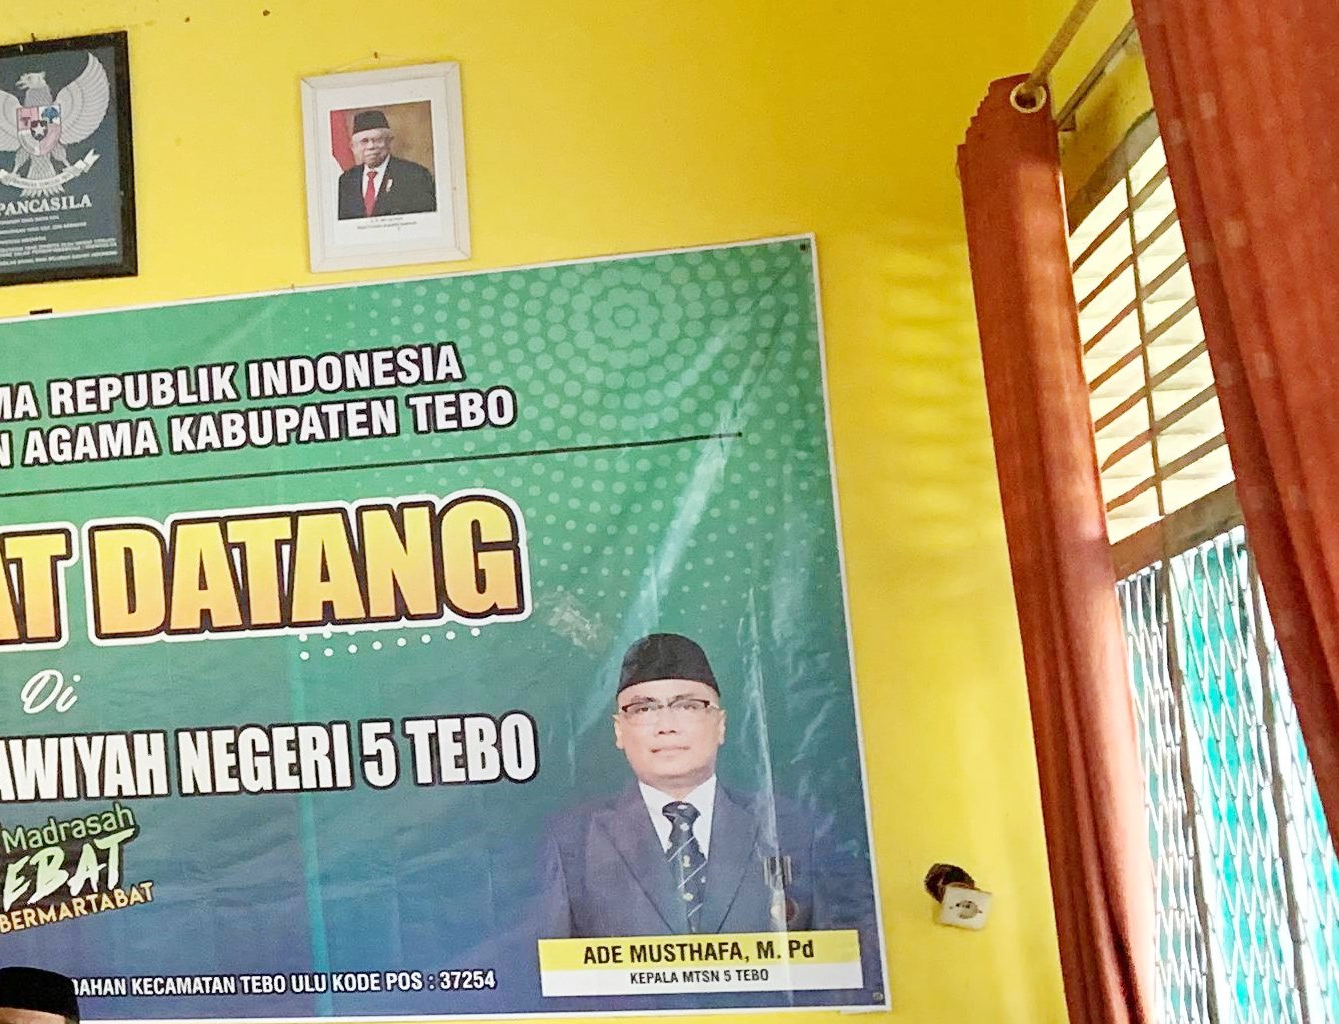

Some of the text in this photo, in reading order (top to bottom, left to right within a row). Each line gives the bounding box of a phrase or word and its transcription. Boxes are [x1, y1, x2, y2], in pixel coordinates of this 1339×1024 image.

[49, 362, 238, 416] REPUBLIK
[247, 343, 463, 399] INDONESIA
[22, 420, 161, 467] AGAMA
[170, 398, 398, 453] KABUPATEN
[408, 387, 517, 432] TEBO
[88, 495, 524, 640] DATANG
[21, 669, 82, 715] Di
[178, 718, 352, 797] NEGERI
[359, 717, 402, 786] 5
[405, 711, 539, 785] TEBO
[1, 800, 136, 854] Madrasah
[583, 939, 815, 965] ADE MUSTHAFA, M. Pd
[630, 968, 769, 985] KEPALA MTSN 5 TEBO
[72, 977, 127, 997] AHAN
[131, 976, 237, 997] KECAMATAN
[240, 974, 287, 995] TEBO
[291, 973, 328, 994] ULU
[331, 972, 381, 993] KODE
[385, 971, 423, 992] POS
[438, 969, 497, 990] 37254
